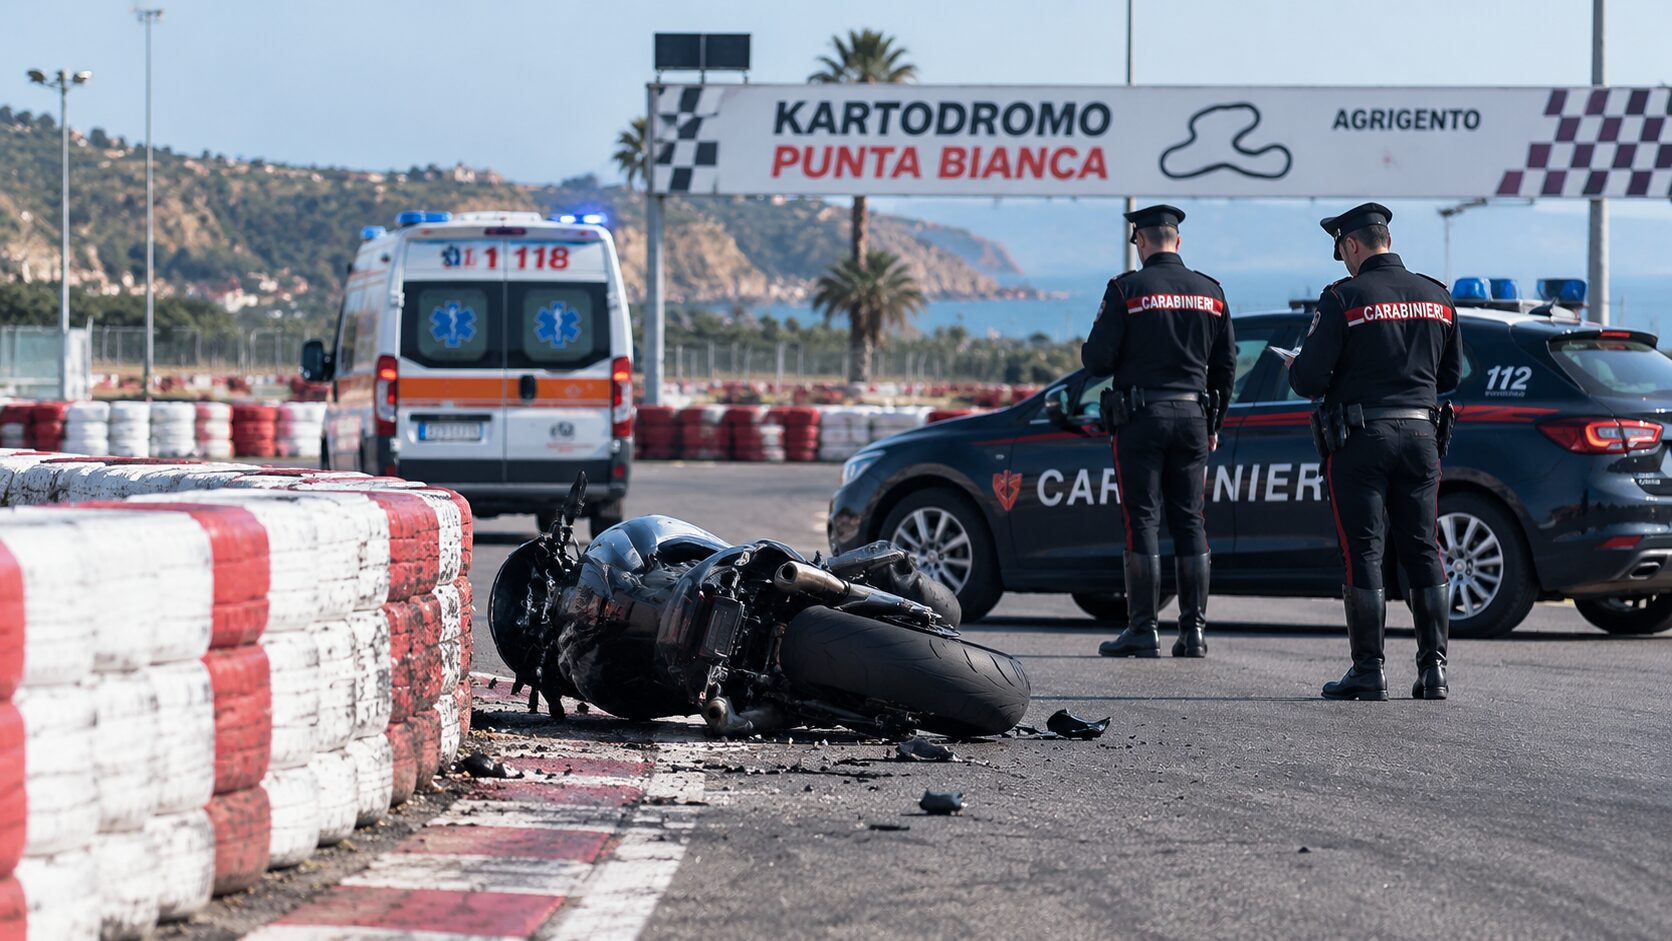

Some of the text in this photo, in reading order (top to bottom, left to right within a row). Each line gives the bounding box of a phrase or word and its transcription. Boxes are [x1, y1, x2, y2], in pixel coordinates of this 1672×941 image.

[773, 101, 1112, 136] KARTODROMO
[1333, 108, 1481, 131] AGRIGENTO
[772, 145, 1109, 180] PUNTA BIANCA
[514, 246, 570, 270] 118
[1141, 294, 1214, 311] CARABINIERI
[1363, 302, 1444, 321] CARABINIERI
[1486, 365, 1532, 390] 112
[1036, 462, 1331, 507] CARNIER
